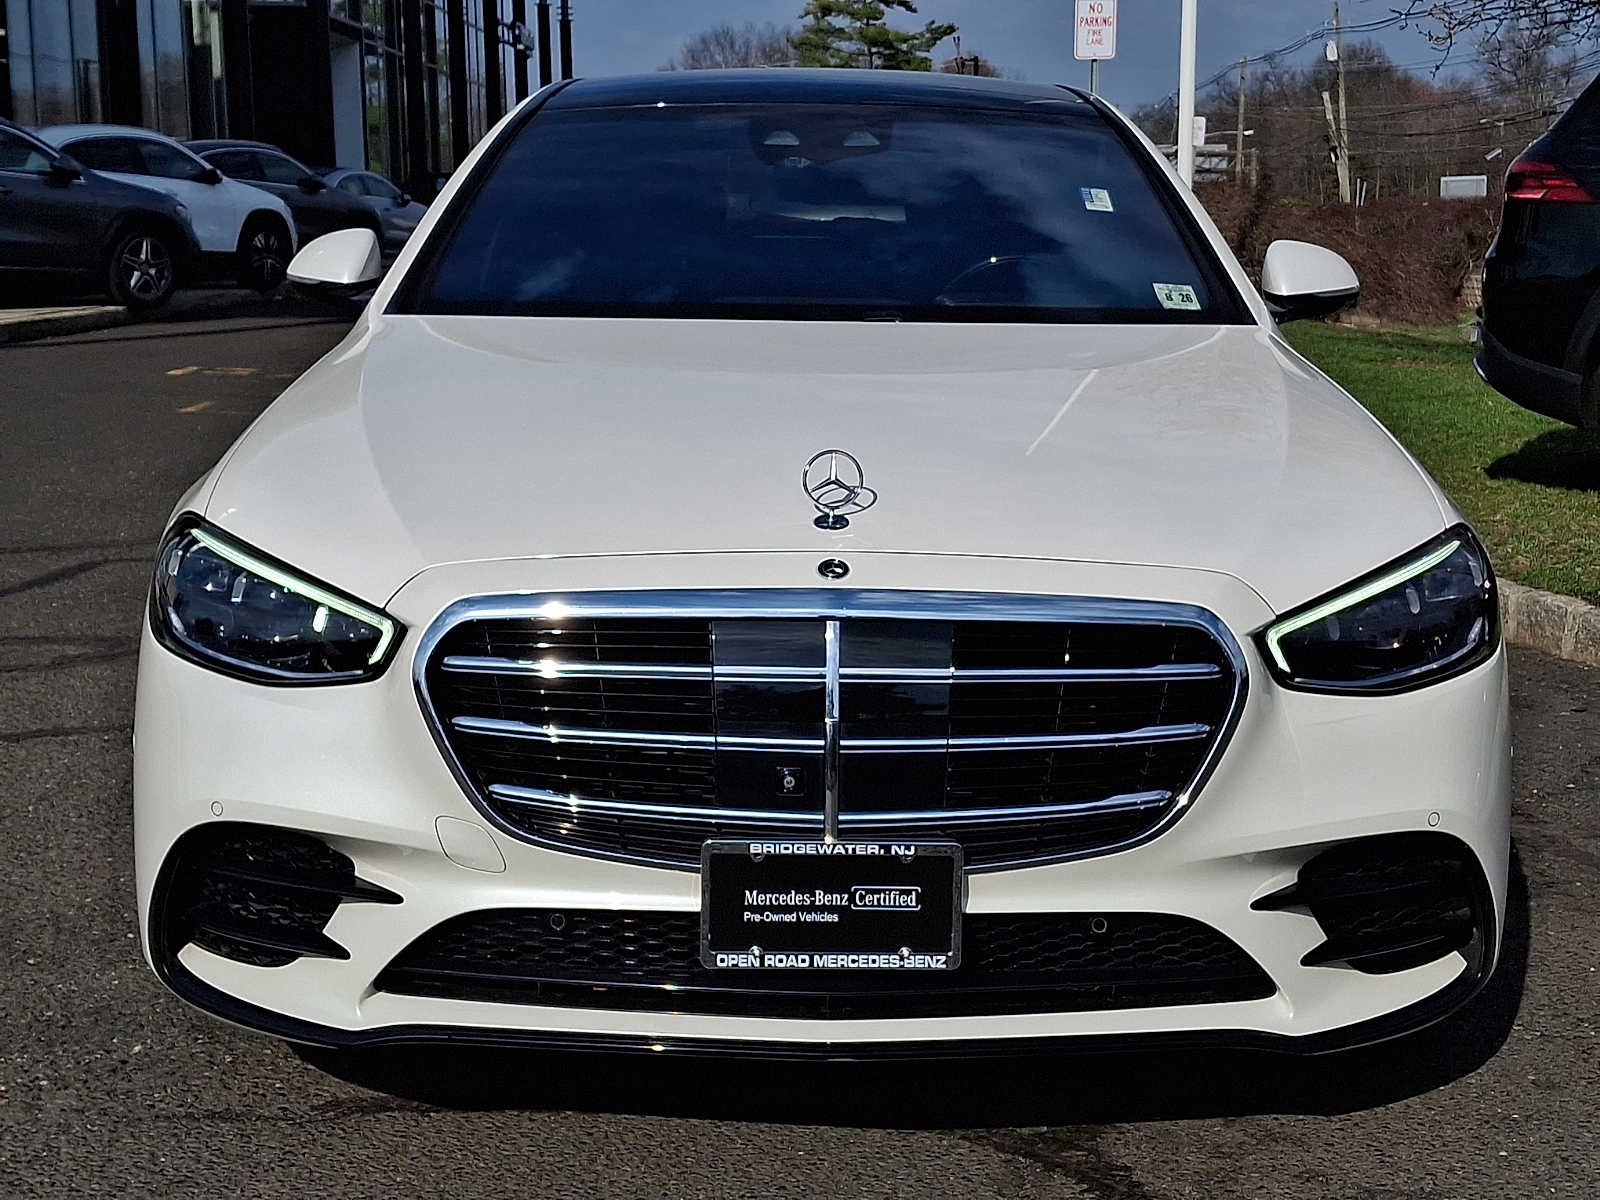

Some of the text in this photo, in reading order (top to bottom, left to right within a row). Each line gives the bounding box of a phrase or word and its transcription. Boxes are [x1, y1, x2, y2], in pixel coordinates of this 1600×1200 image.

[1089, 2, 1103, 14] NO
[1080, 16, 1112, 27] PARKING
[749, 843, 916, 856] BRIDGEWATER, NJ
[744, 889, 917, 906] Mercedes-Benz Certified
[743, 911, 839, 922] Pre-Owned Vehicles
[716, 953, 760, 968] OPEN
[764, 954, 810, 968] ROAD
